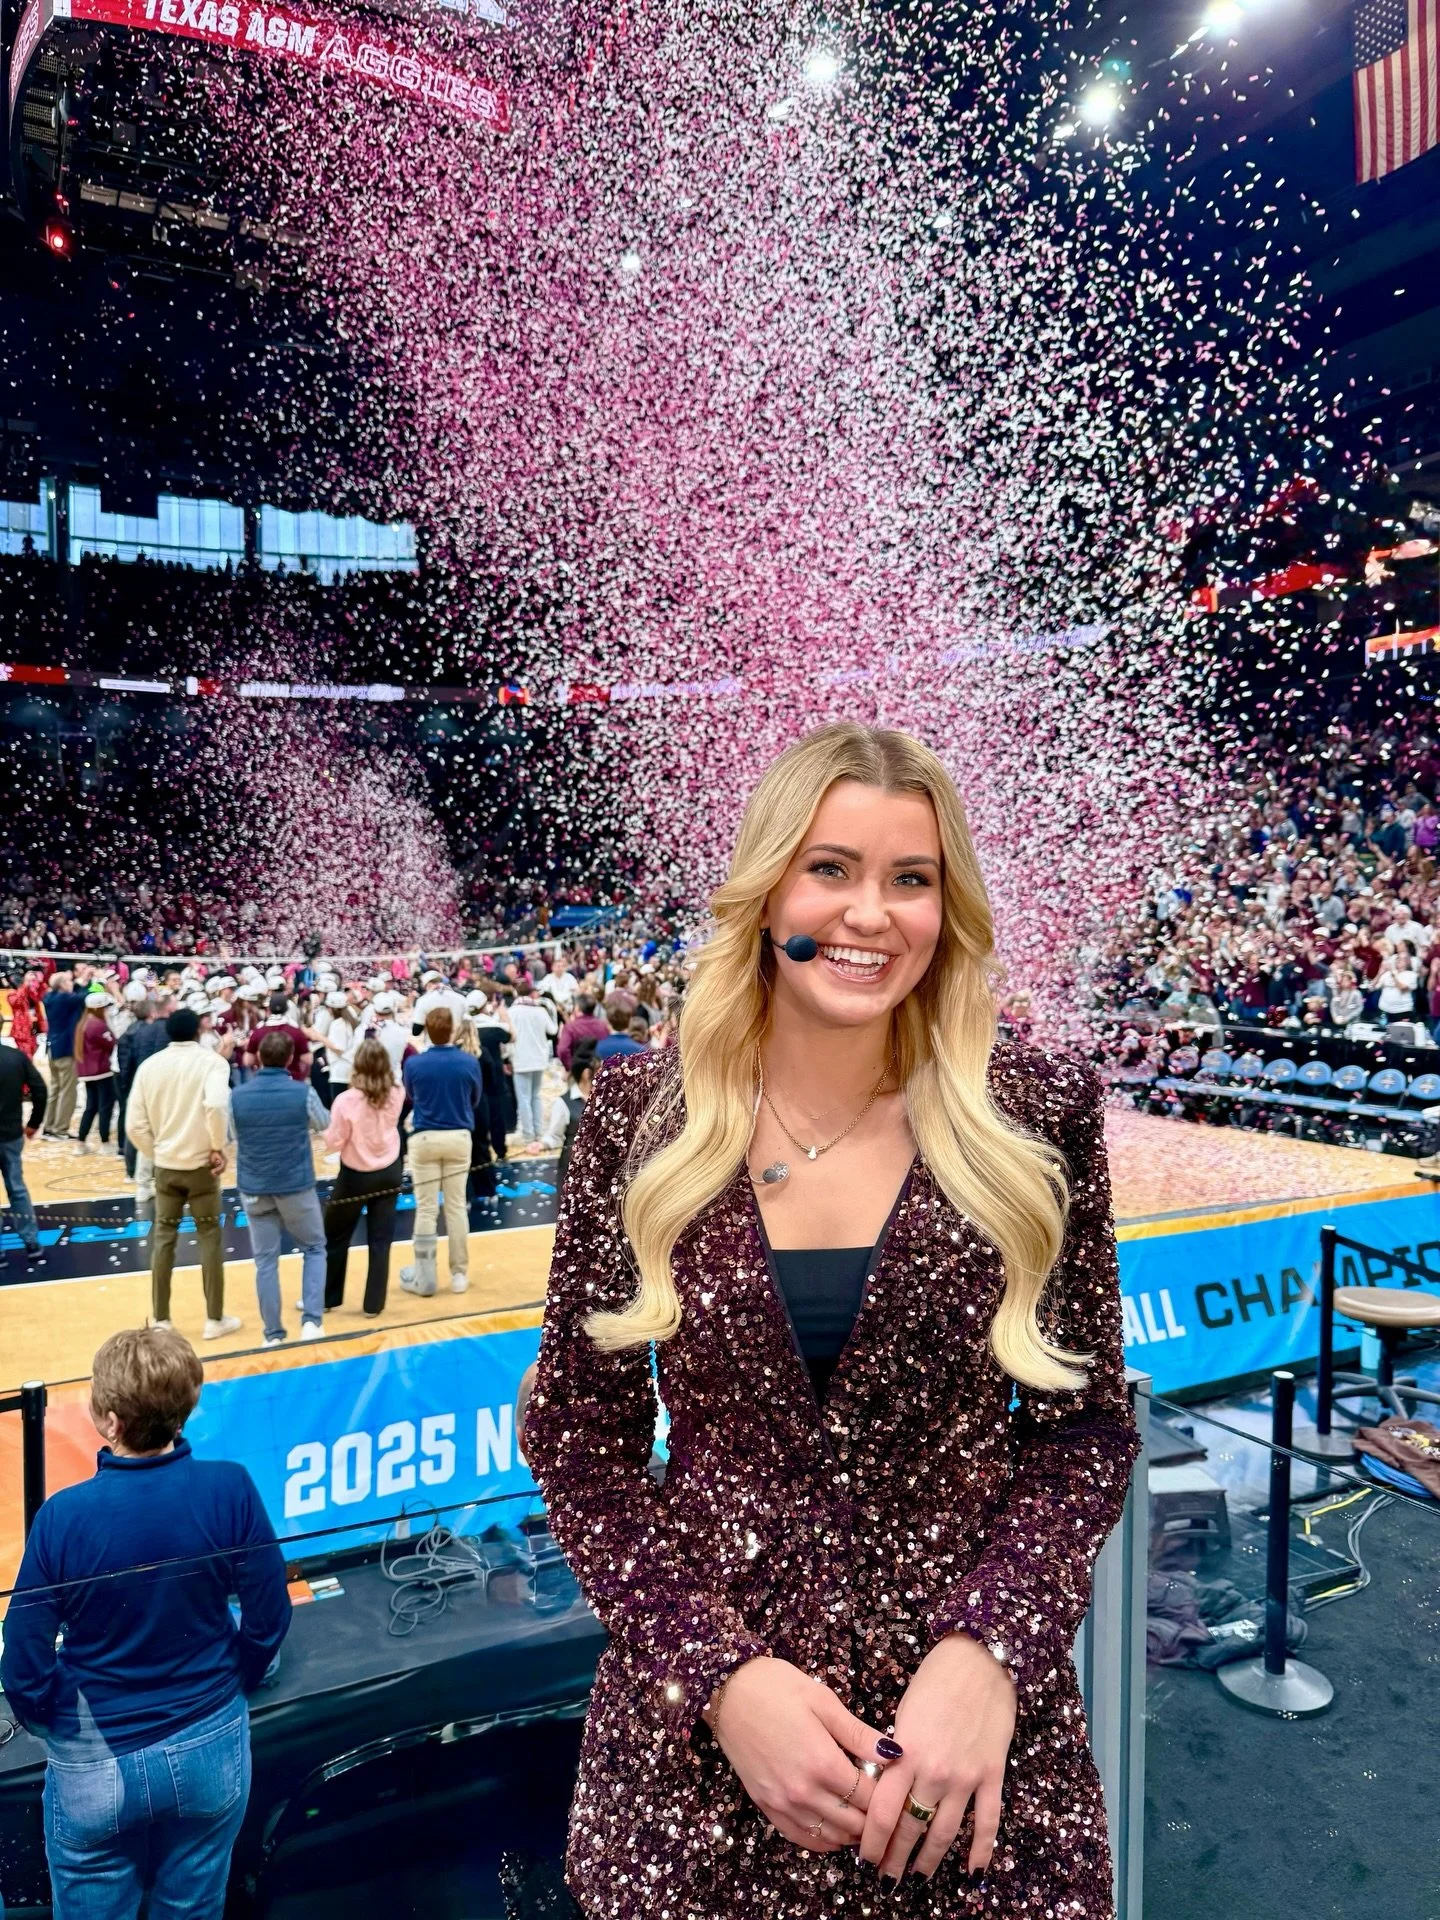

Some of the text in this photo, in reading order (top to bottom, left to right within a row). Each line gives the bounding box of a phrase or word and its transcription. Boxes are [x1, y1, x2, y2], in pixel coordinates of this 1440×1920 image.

[145, 0, 498, 120] TEXAS A&M AGGIES
[284, 1413, 456, 1518] 2025
[476, 1403, 531, 1476] N
